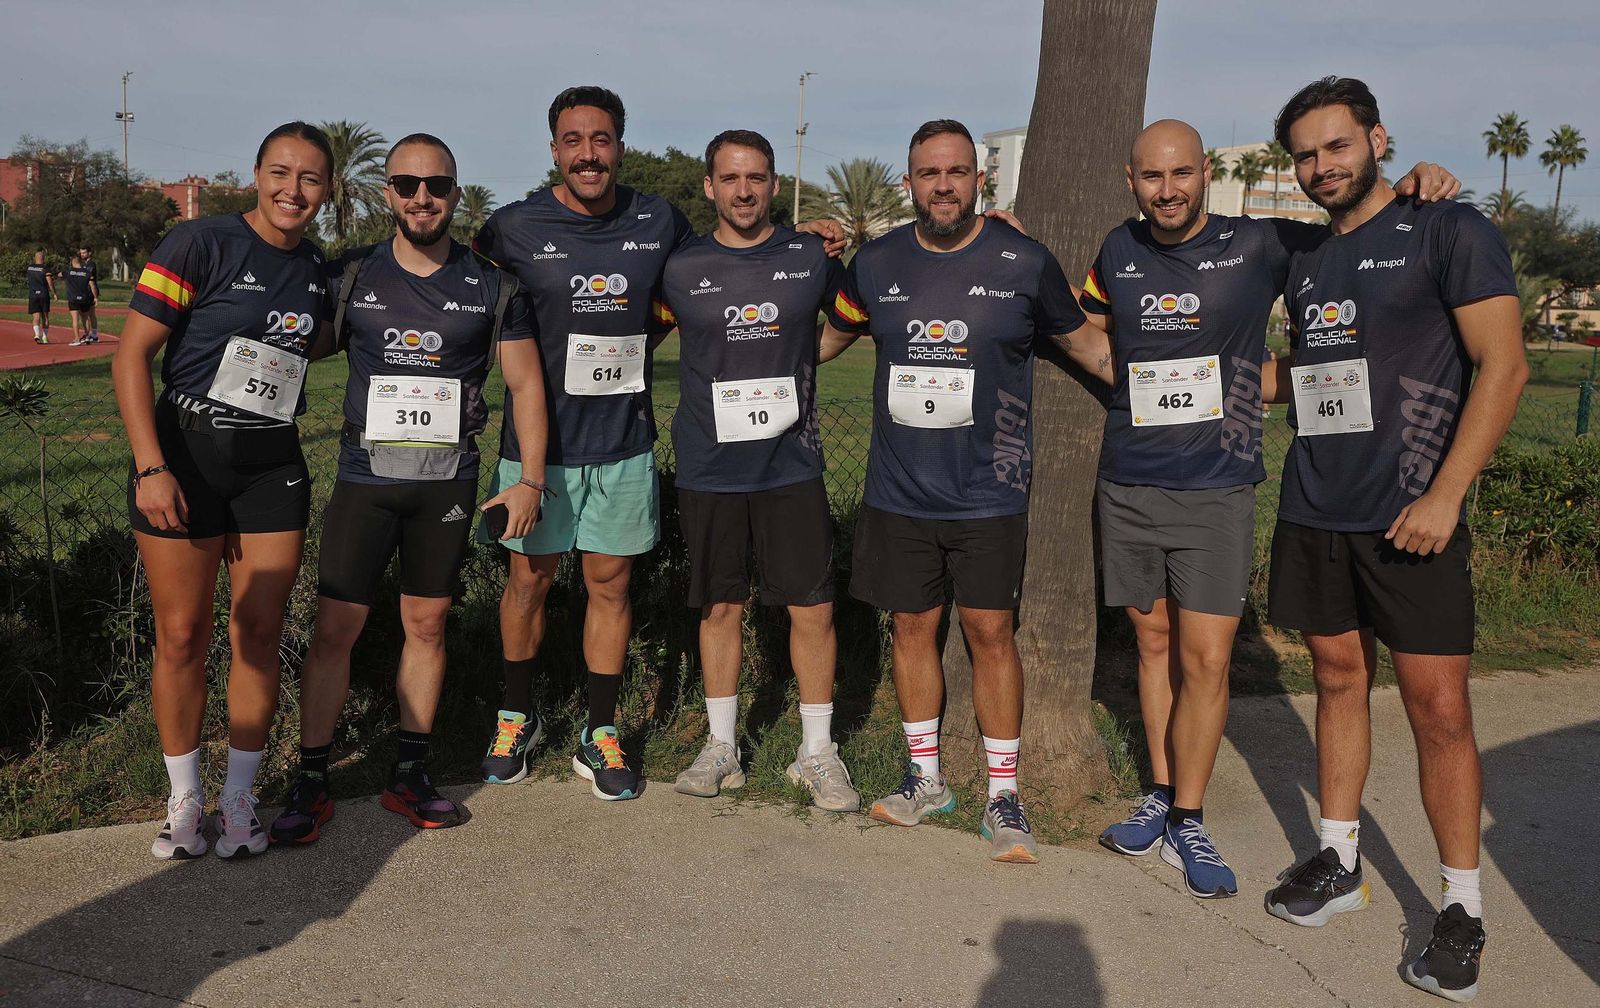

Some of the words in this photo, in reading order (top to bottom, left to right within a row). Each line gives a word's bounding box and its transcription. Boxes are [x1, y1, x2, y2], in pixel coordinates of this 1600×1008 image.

[639, 241, 660, 250] mupol
[532, 252, 569, 260] Santander
[1216, 255, 1244, 269] mupol
[1376, 257, 1406, 269] mupol
[789, 270, 811, 281] mupol
[231, 282, 267, 292] Santander
[570, 273, 628, 297] 200
[690, 286, 723, 296] Santander
[988, 290, 1016, 299] mupol
[572, 298, 617, 307] POLICIA
[879, 295, 910, 303] Santander
[1140, 293, 1200, 316] 200
[353, 301, 388, 311] Santander
[461, 305, 486, 314] mupol
[572, 304, 628, 313] NACIONAL
[724, 302, 779, 328] 200
[1305, 299, 1357, 330] 200
[265, 310, 314, 336] 200
[726, 326, 769, 336] POLICIA
[727, 331, 780, 342] NACIONAL
[907, 319, 969, 344] 200
[1306, 329, 1348, 340] POLICIA
[383, 327, 443, 352] 200
[1307, 337, 1357, 348] NACIONAL
[384, 352, 429, 361] POLICIA
[384, 358, 441, 368] NACIONAL
[592, 367, 622, 381] 614
[244, 377, 279, 401] 575
[1158, 392, 1194, 409] 462
[925, 400, 935, 414] 9
[1317, 399, 1344, 417] 461
[395, 409, 432, 426] 310
[747, 410, 769, 425] 10
[441, 513, 468, 523] adidas
